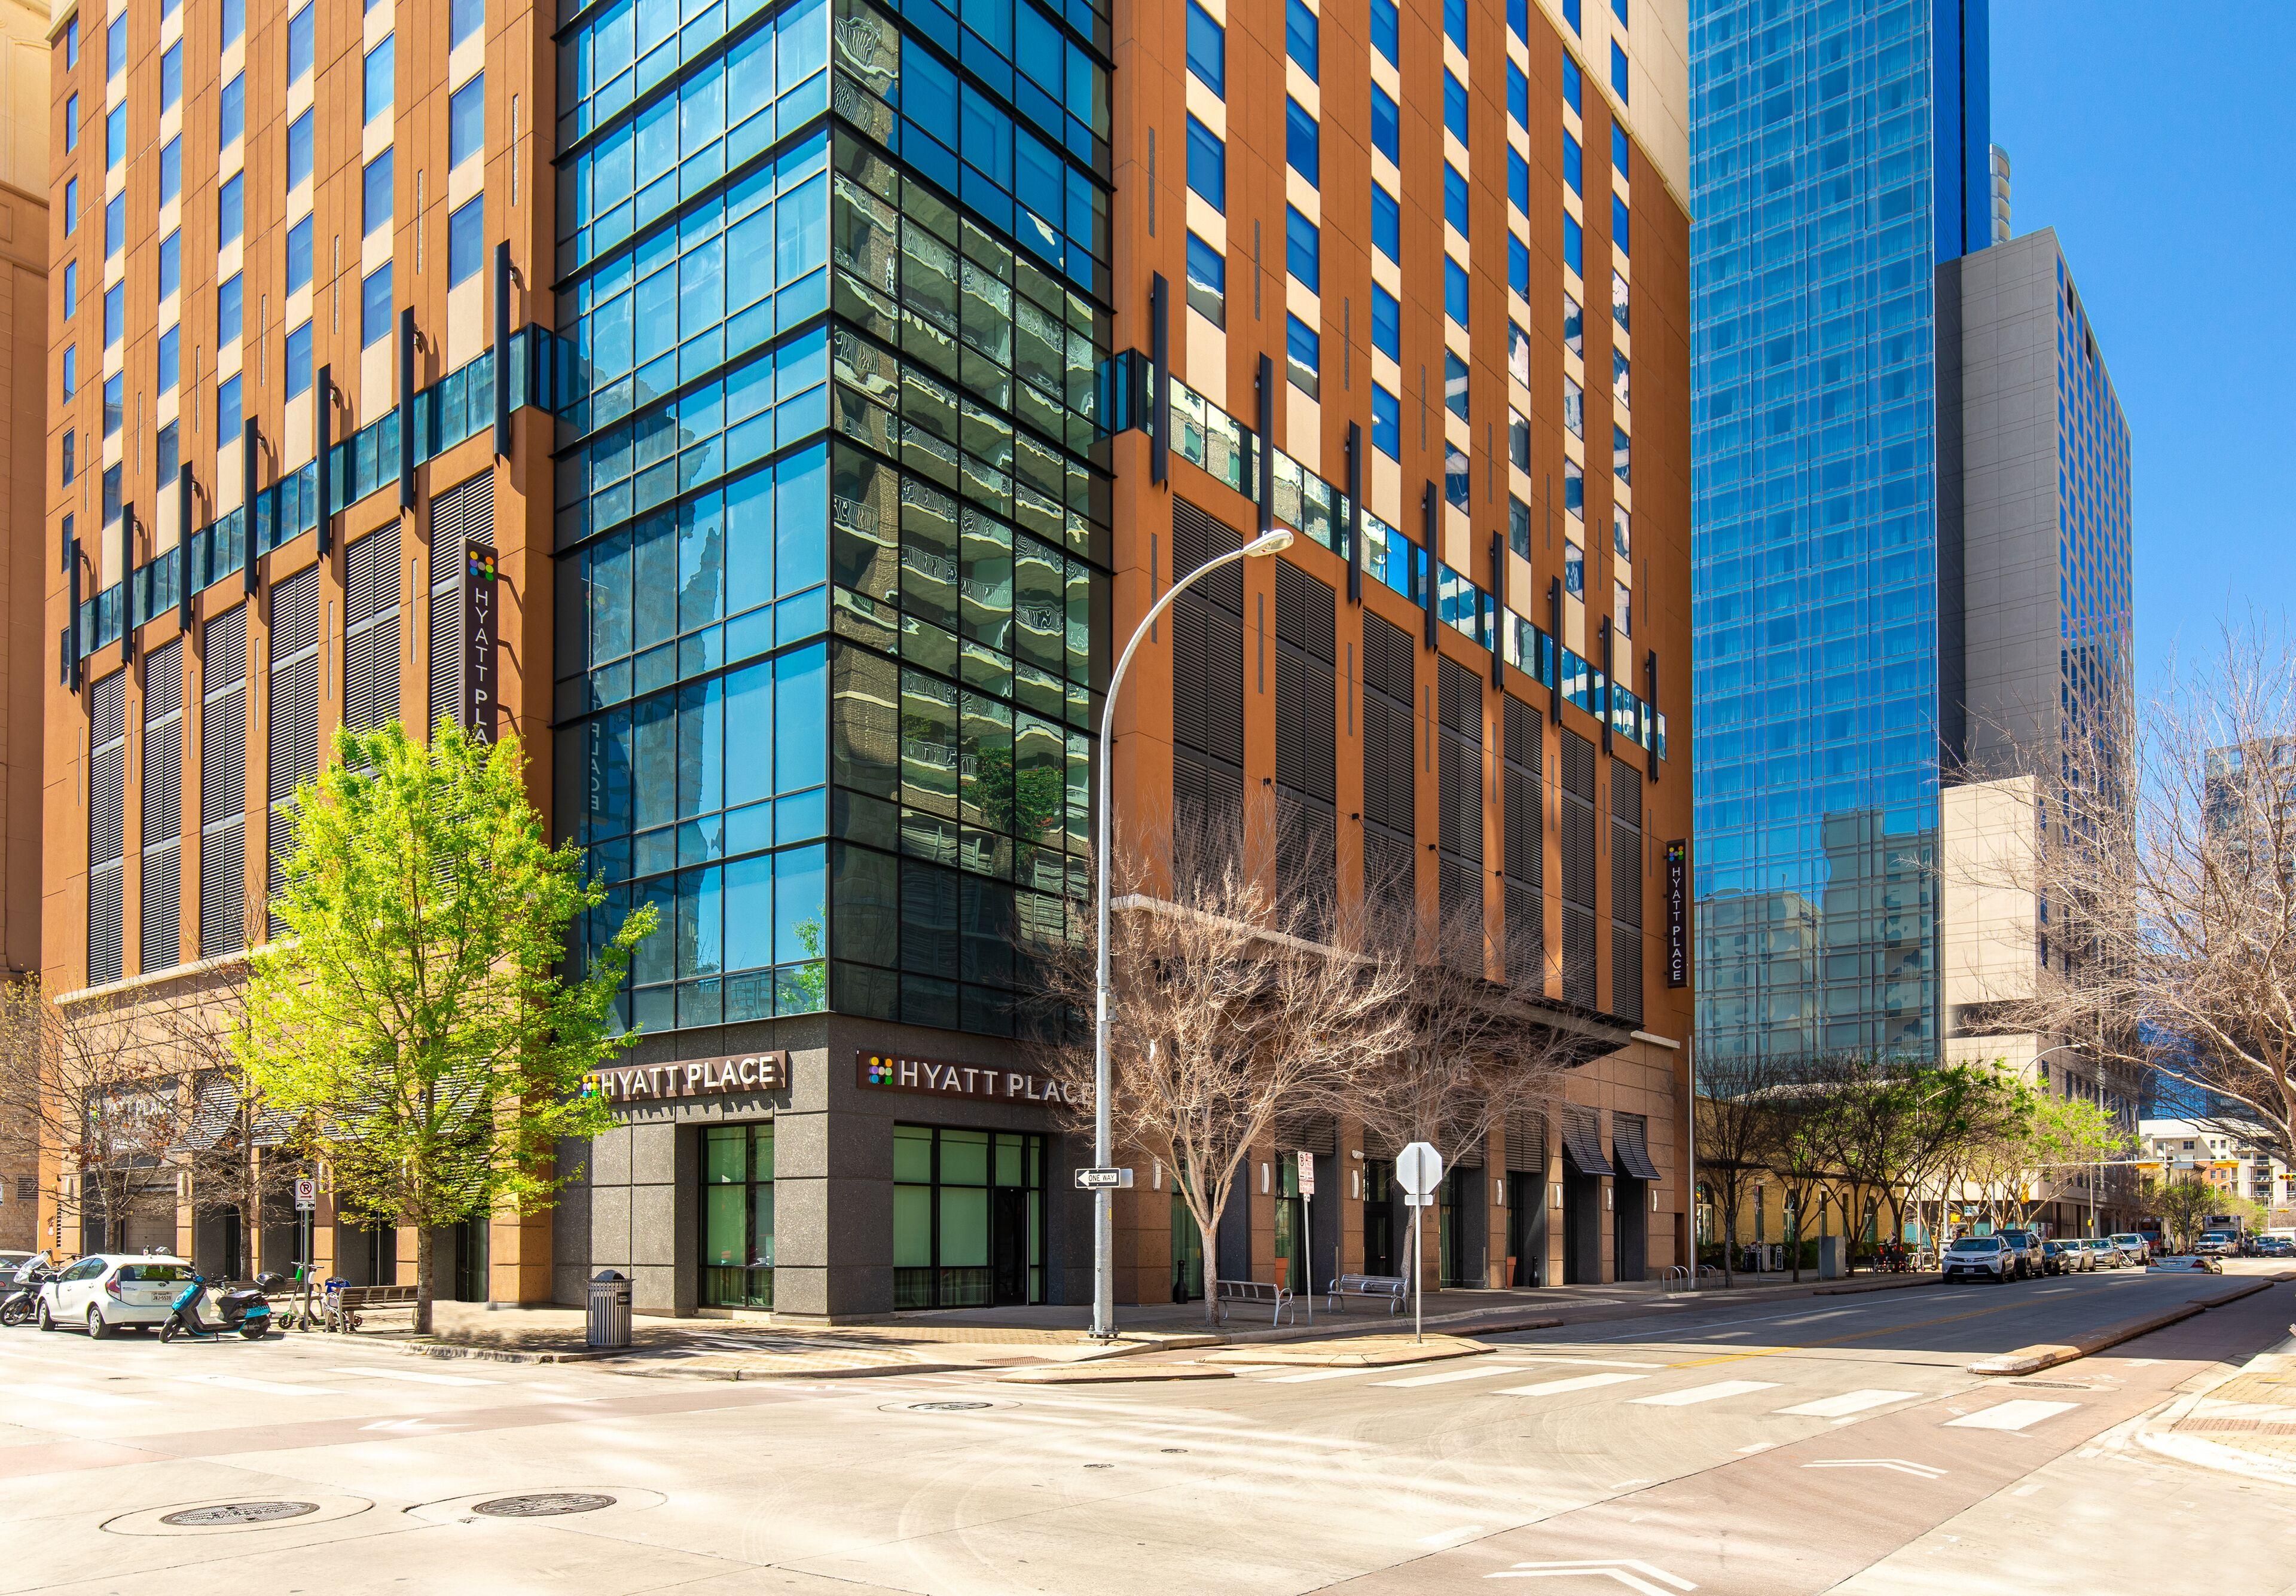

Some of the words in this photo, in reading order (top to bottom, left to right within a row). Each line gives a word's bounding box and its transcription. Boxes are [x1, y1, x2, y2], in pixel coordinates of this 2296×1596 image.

[475, 588, 488, 681] HYATT
[1672, 866, 1681, 921] HYATT
[1672, 926, 1682, 980] PLACE
[602, 1065, 682, 1096] HYATT
[688, 1056, 777, 1089] PLACE
[897, 1060, 999, 1095] HYATT
[1006, 1073, 1094, 1105] PLACE
